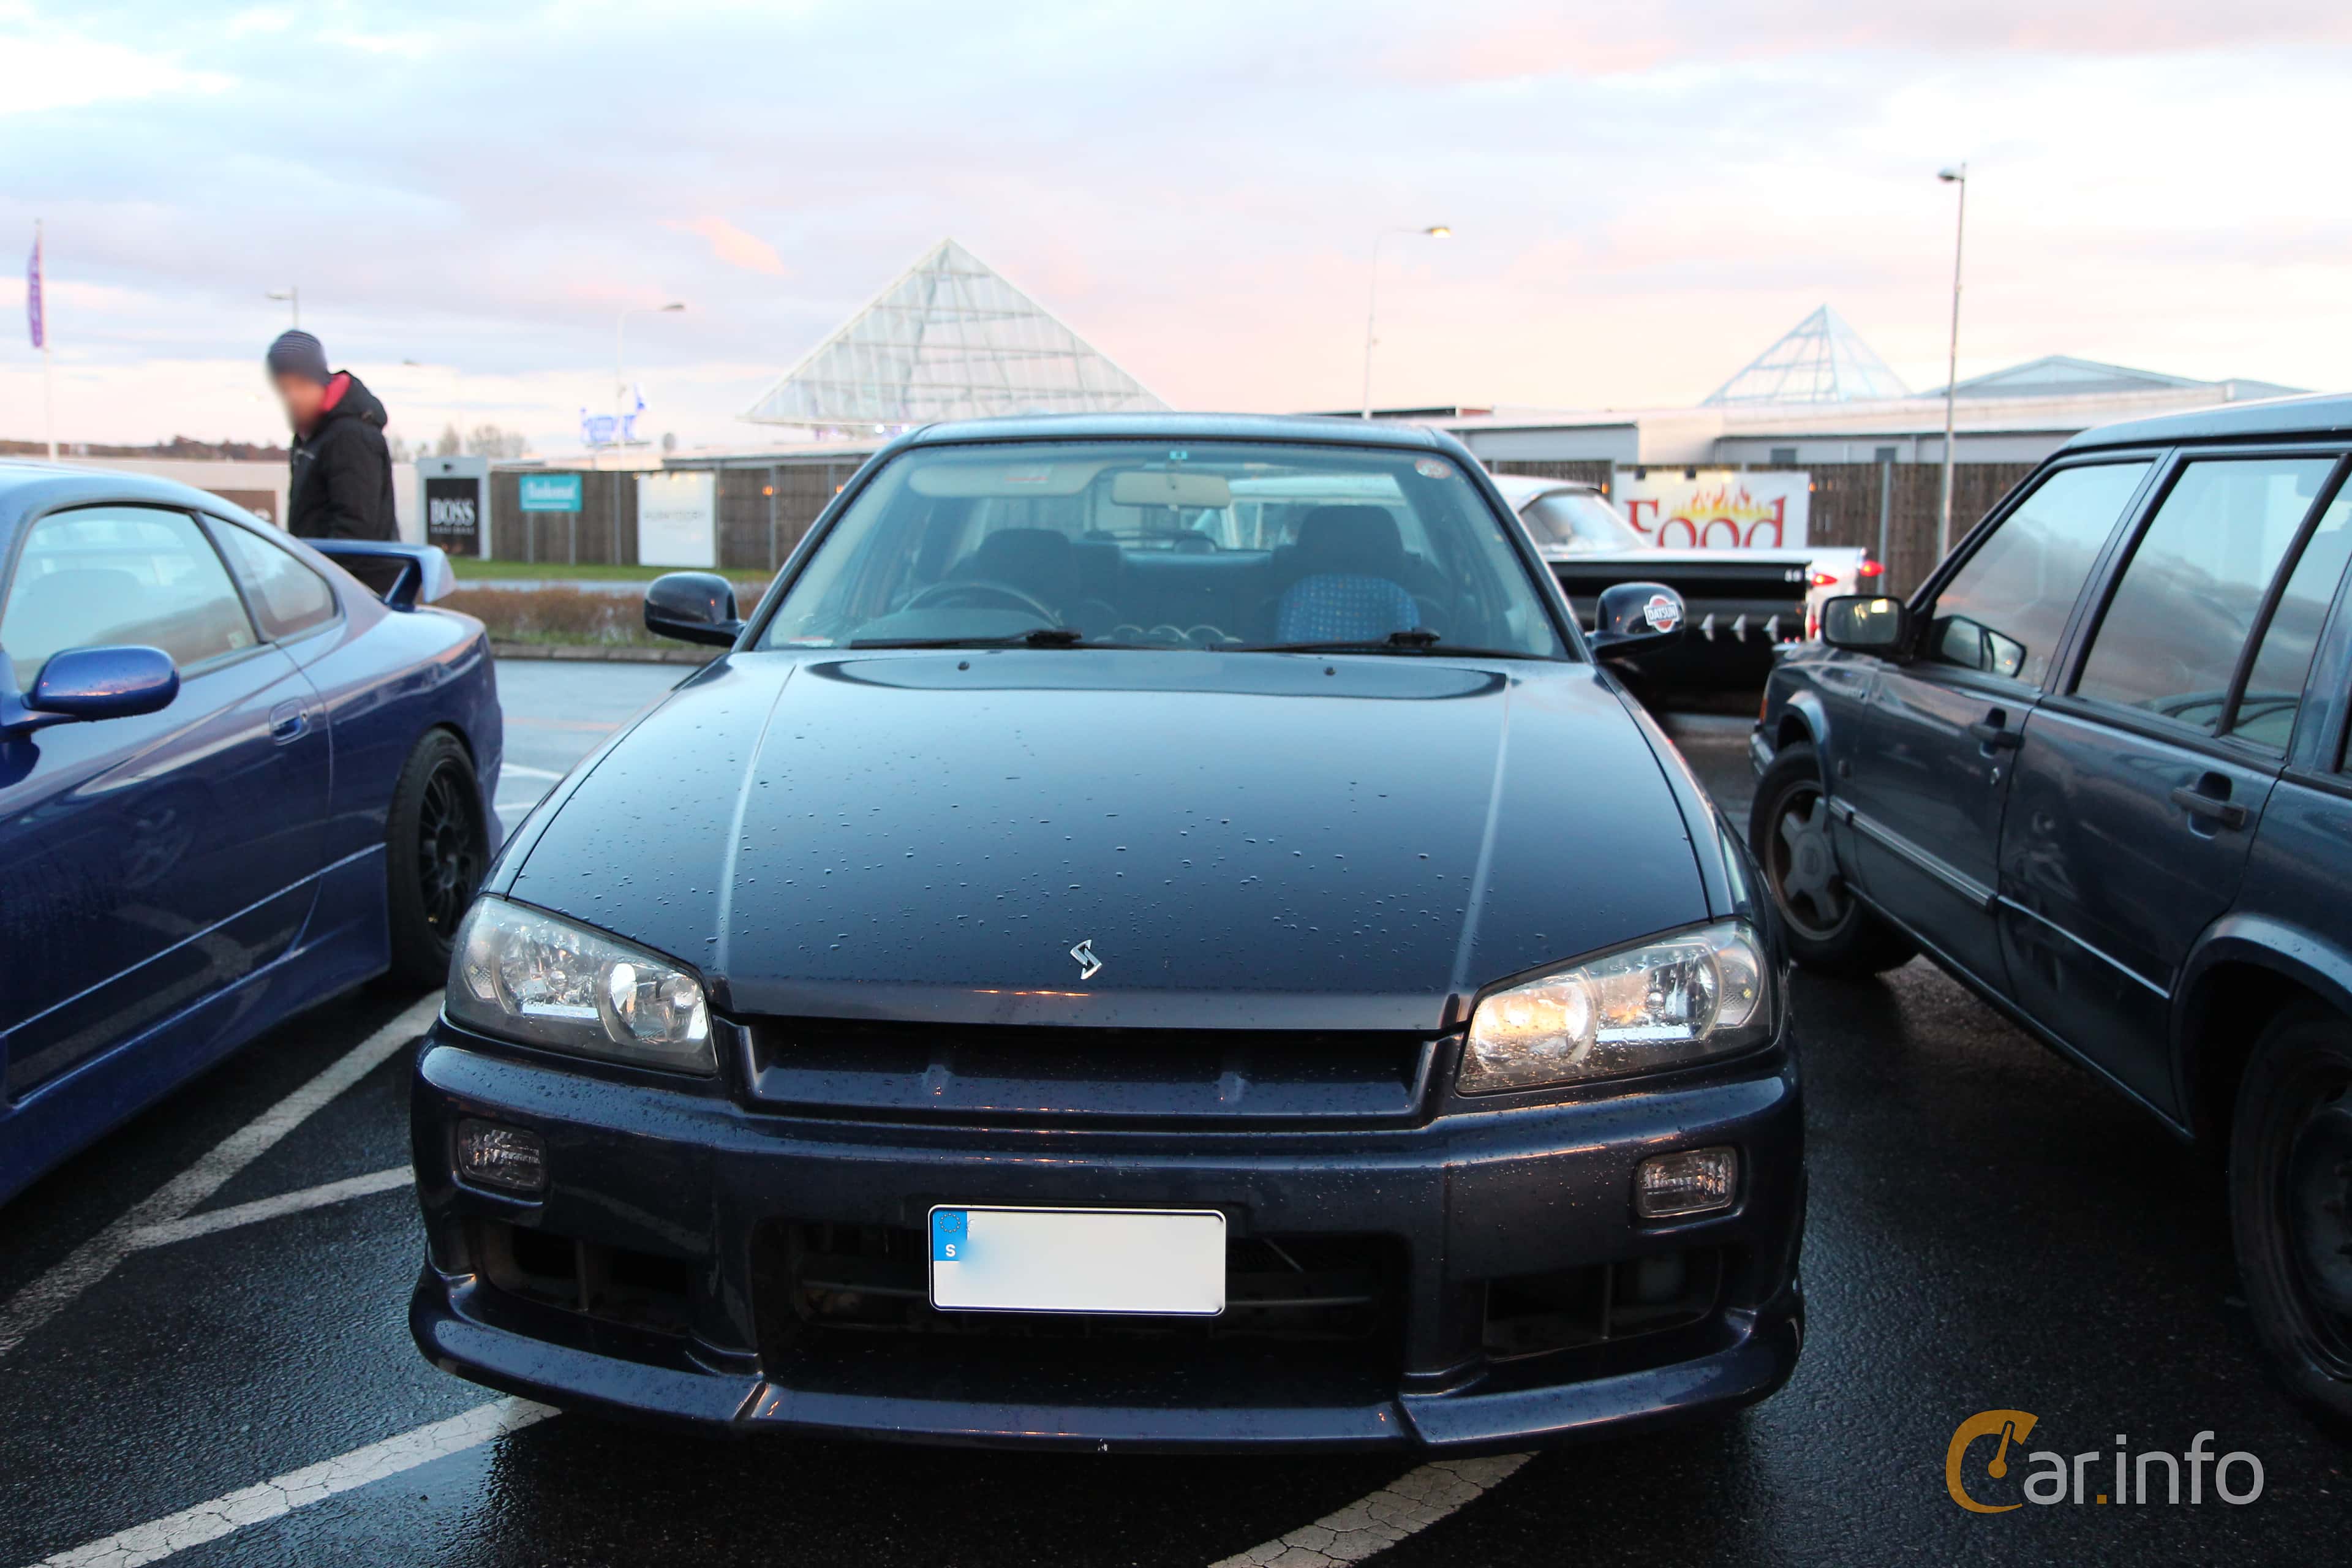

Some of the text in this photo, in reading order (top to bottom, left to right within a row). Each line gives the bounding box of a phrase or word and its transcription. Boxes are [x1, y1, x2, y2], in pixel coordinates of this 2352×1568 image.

[430, 498, 475, 526] BOSS
[1623, 494, 1787, 548] Food
[1647, 605, 1676, 620] DATSUN
[945, 1243, 956, 1257] S
